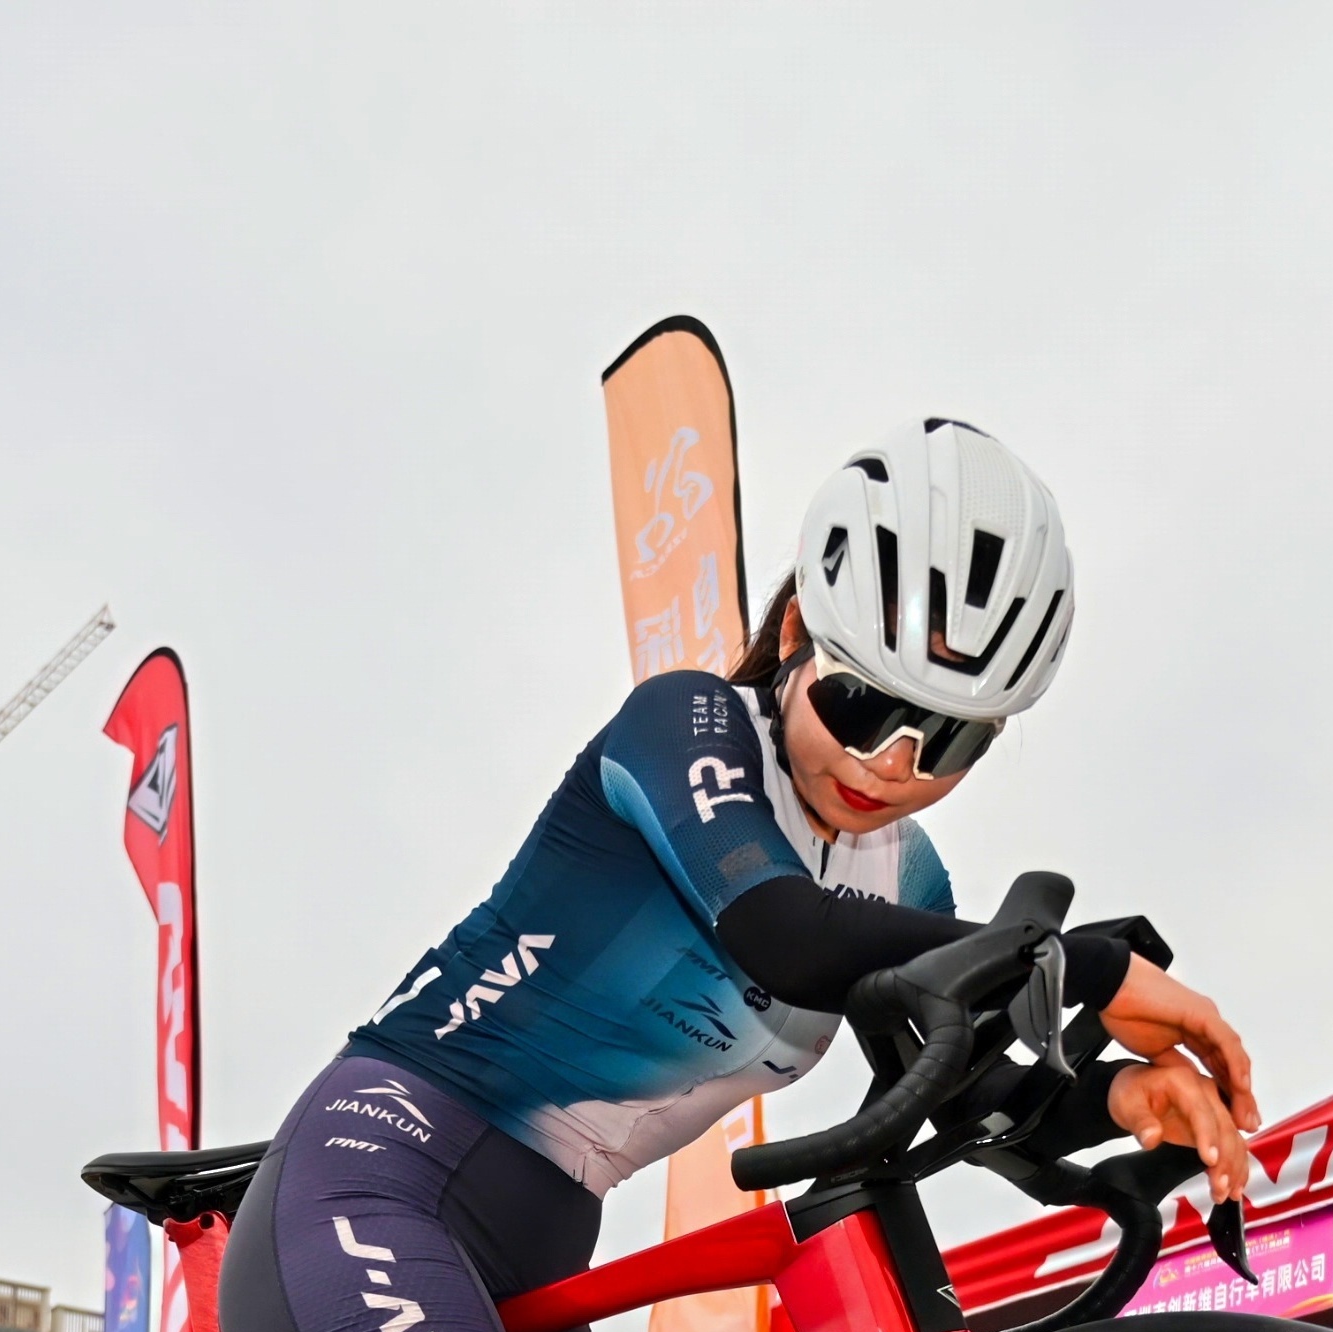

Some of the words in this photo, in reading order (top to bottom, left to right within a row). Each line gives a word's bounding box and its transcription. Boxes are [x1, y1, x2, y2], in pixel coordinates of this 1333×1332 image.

[693, 695, 708, 736] TEAM
[713, 690, 728, 733] RACIN
[434, 934, 556, 1040] JAVA
[746, 990, 769, 1008] KMC
[640, 997, 733, 1051] JIANKUN
[325, 1099, 432, 1143] JIANKUN
[324, 1137, 387, 1152] PMT
[1124, 1252, 1326, 1316] 市创新维自行车有限公司
